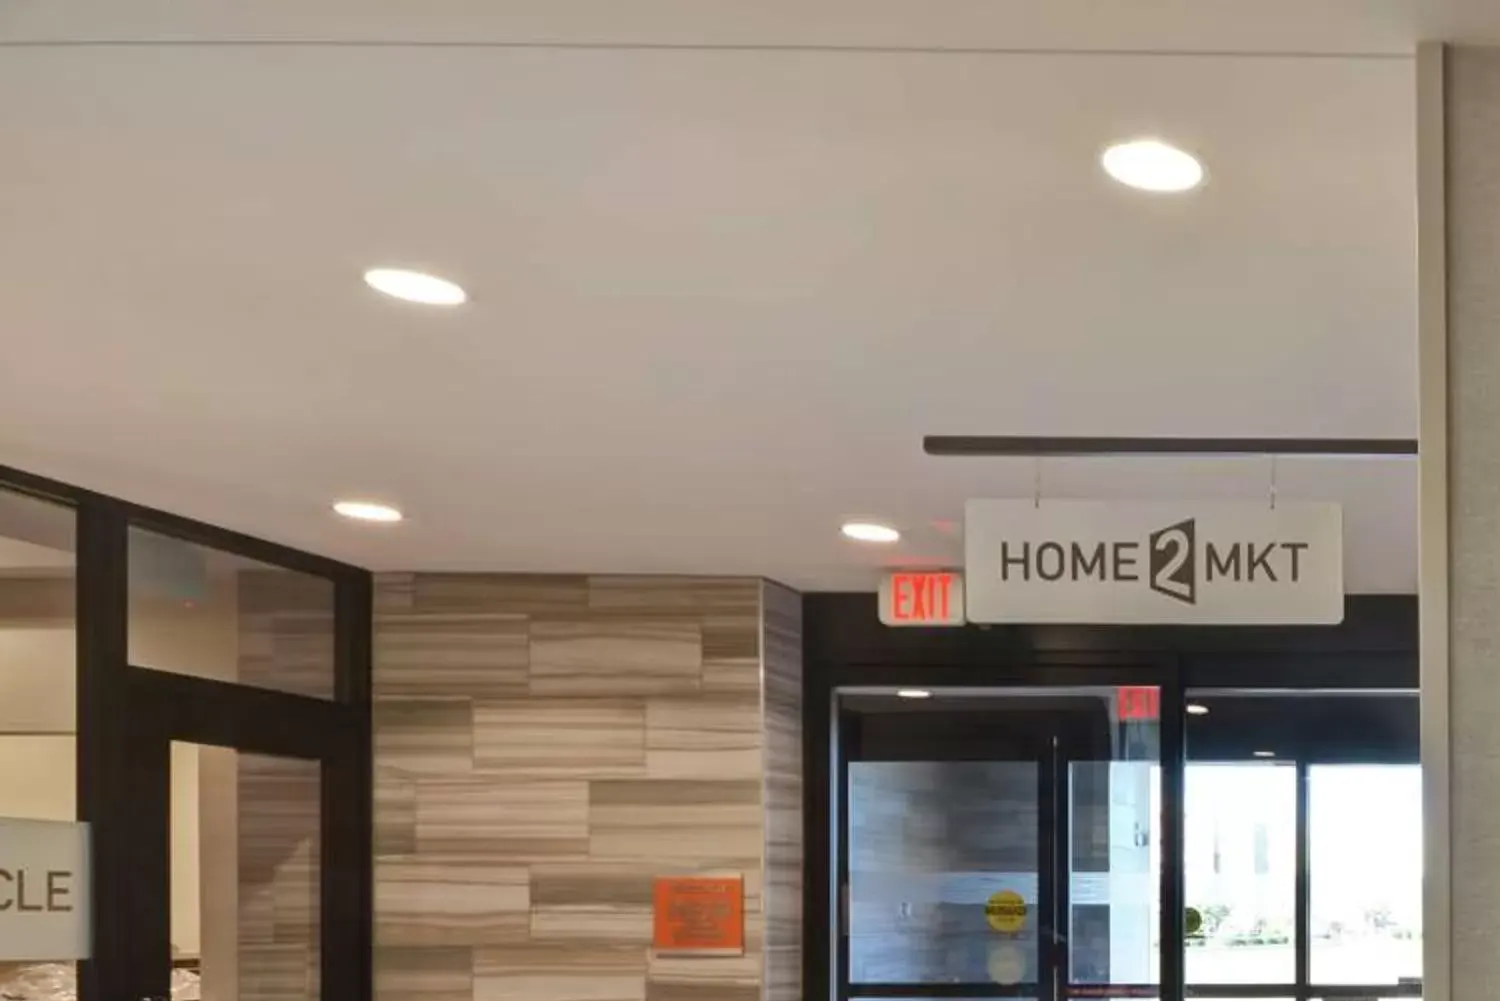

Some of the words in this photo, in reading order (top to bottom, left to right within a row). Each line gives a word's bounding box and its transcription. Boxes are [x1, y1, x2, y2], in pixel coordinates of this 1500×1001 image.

[1000, 540, 1139, 582] HOME
[1205, 541, 1309, 582] MKT
[890, 573, 951, 620] EXIT
